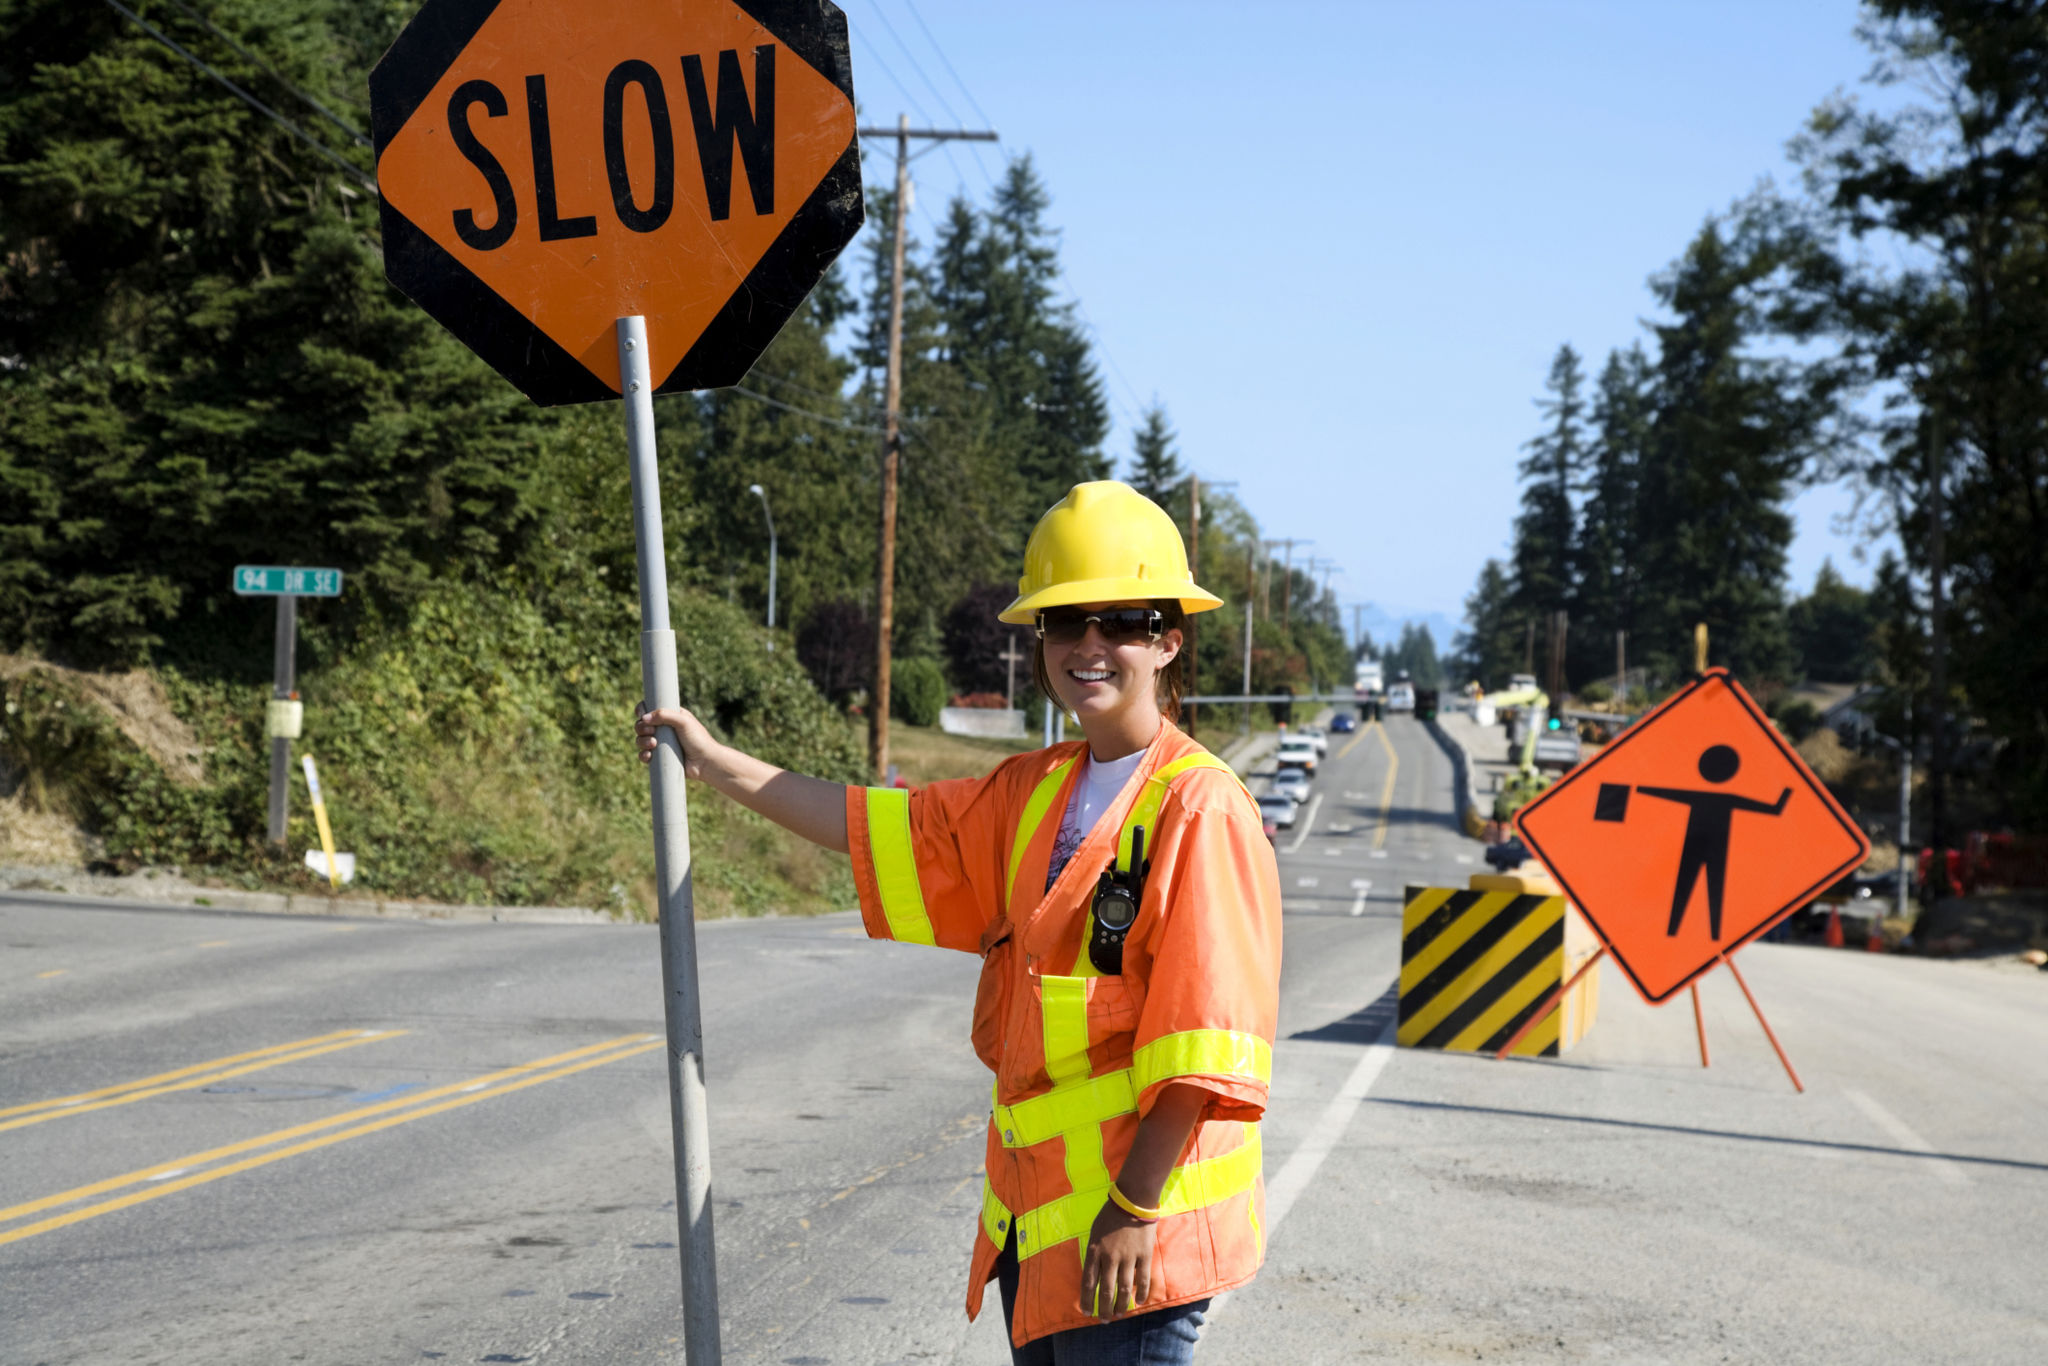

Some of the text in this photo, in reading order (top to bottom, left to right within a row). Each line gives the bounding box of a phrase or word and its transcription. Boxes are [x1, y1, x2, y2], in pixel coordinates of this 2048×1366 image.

[447, 43, 776, 251] SLOW
[243, 570, 266, 591] 94
[314, 572, 332, 593] SE
